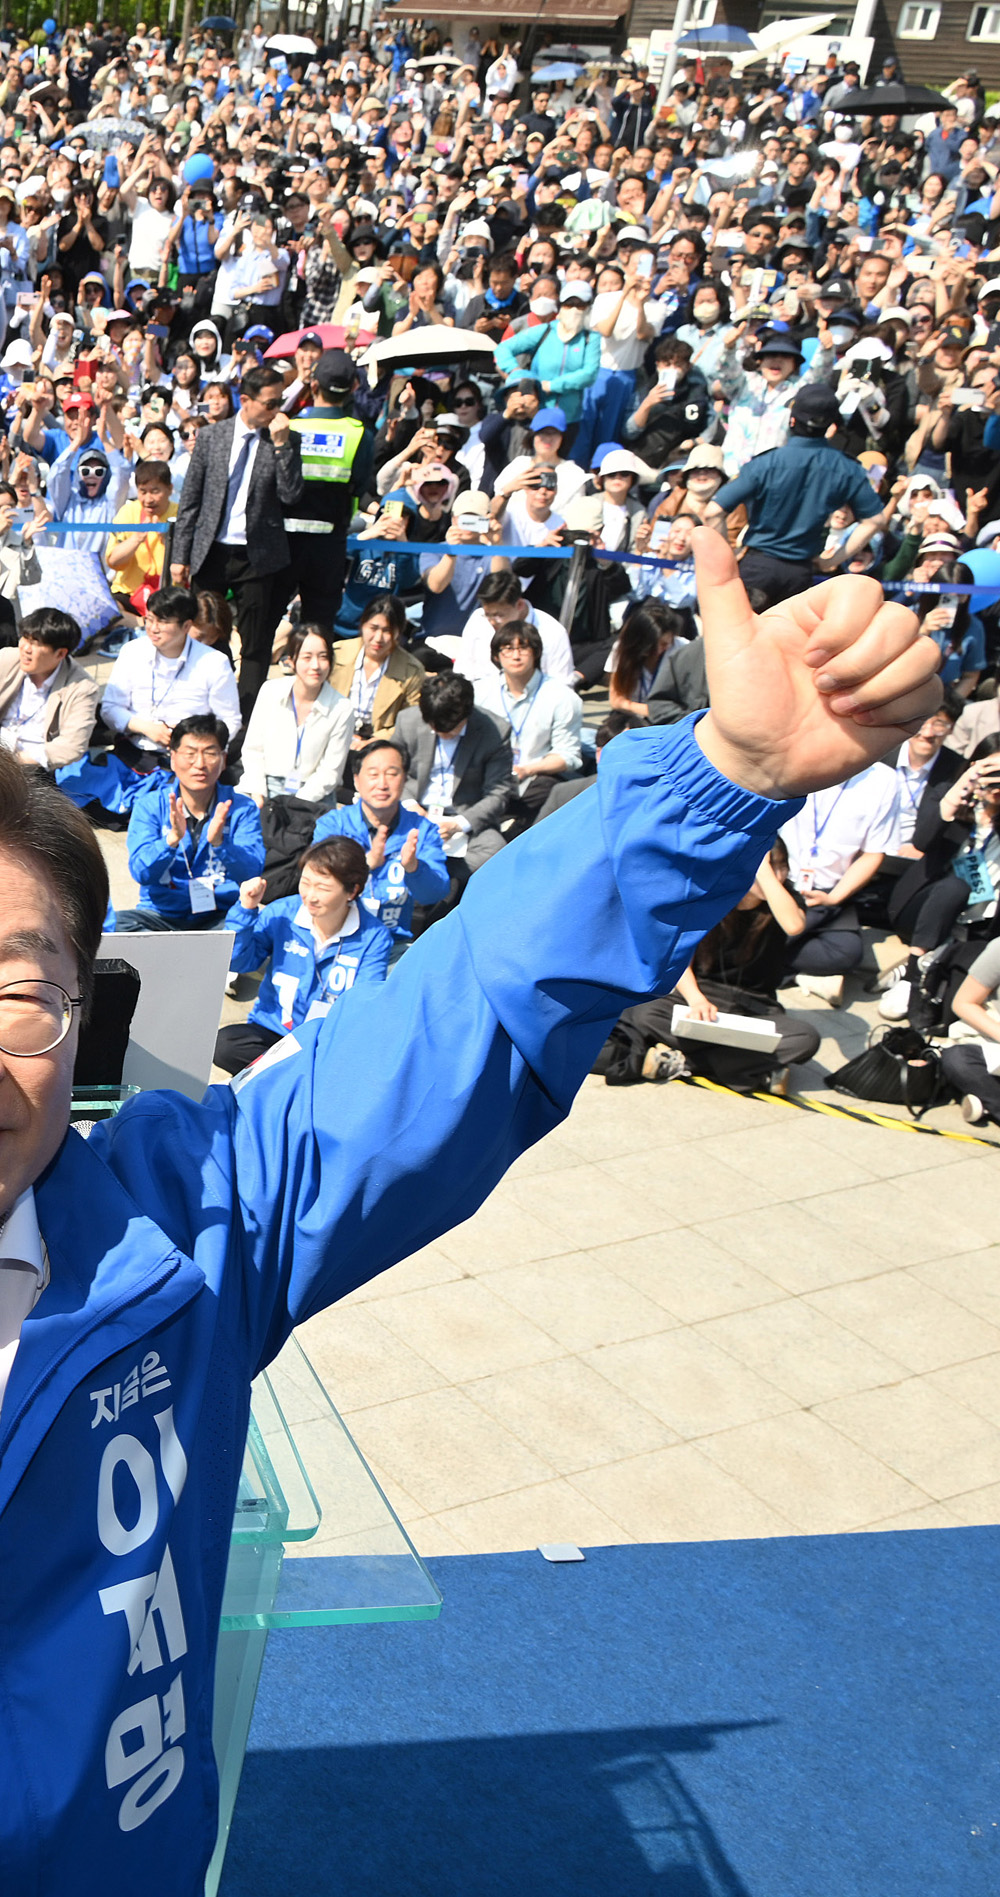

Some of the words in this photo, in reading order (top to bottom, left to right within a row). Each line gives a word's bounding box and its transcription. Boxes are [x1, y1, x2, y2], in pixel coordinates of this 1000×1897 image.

[685, 403, 699, 420] C
[966, 855, 986, 894] PRESS
[272, 972, 300, 1031] 1
[89, 1350, 172, 1429] 지금은
[97, 1403, 188, 1832] 이재명
